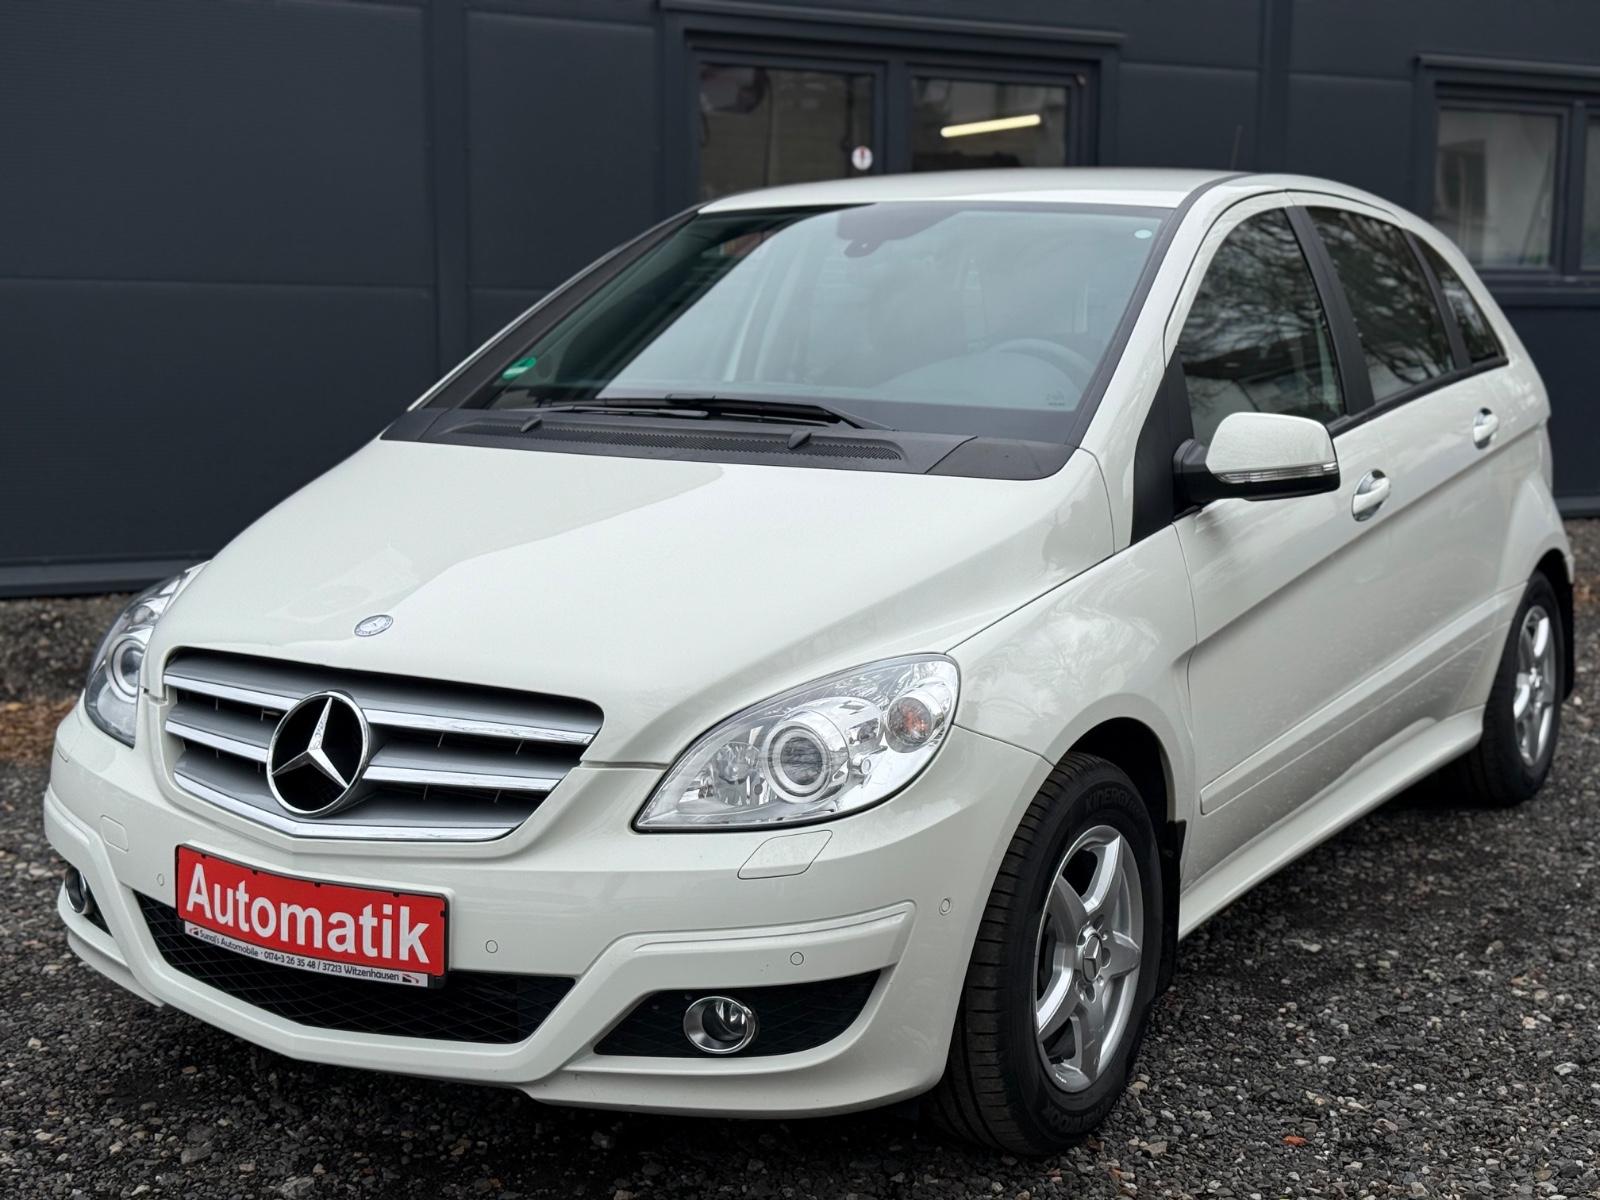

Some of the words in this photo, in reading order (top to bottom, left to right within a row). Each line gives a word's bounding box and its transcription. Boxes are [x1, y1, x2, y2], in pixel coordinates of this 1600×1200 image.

[186, 862, 430, 964] Automatik
[221, 937, 259, 956] Automobile
[264, 951, 285, 963] 0174-3
[286, 956, 295, 965] 26
[297, 958, 305, 967] 35
[307, 960, 316, 969] 48
[322, 962, 342, 973] 37213
[343, 965, 399, 981] Witzenhausen
